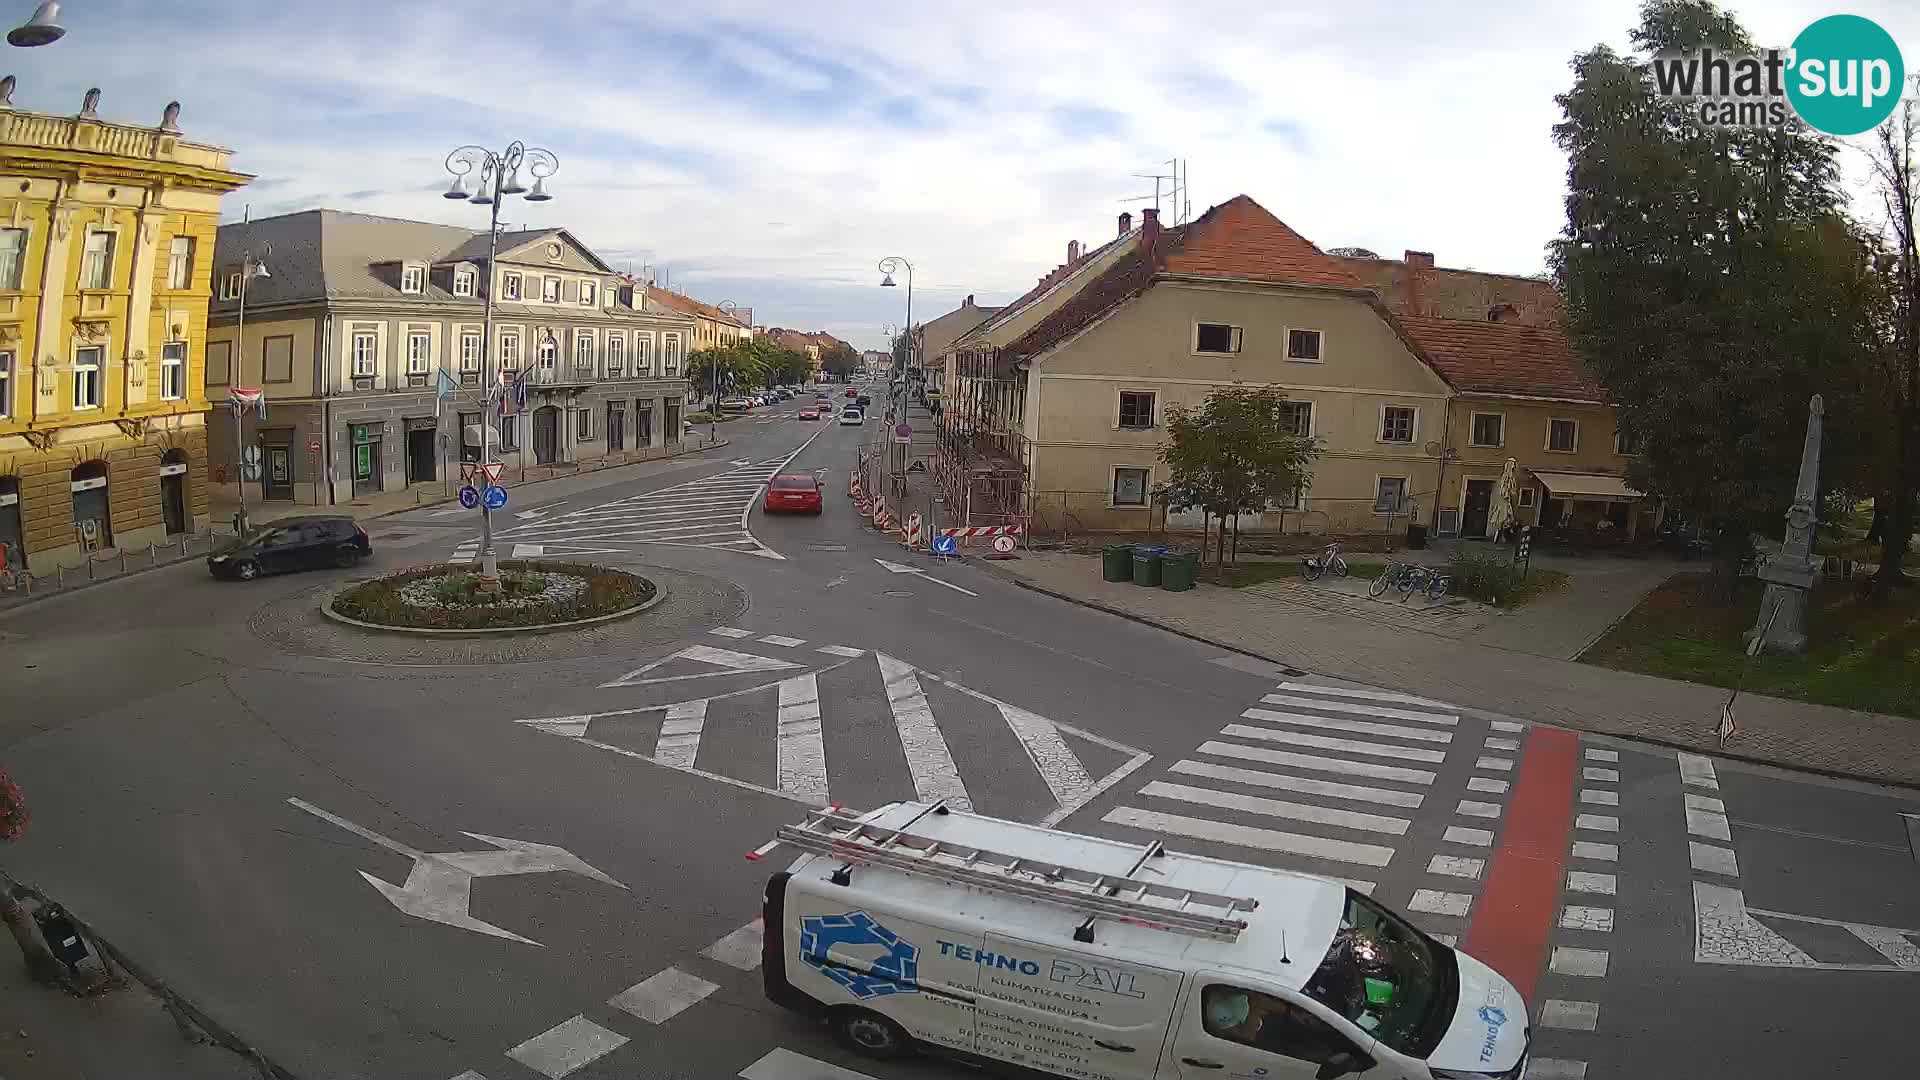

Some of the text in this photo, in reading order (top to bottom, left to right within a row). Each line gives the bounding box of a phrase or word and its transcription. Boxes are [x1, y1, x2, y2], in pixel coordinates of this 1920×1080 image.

[936, 940, 1147, 999] TEHNO PAL
[991, 976, 1092, 1006] KLIMATIZACIJA
[1479, 1027, 1499, 1063] TEHNO
